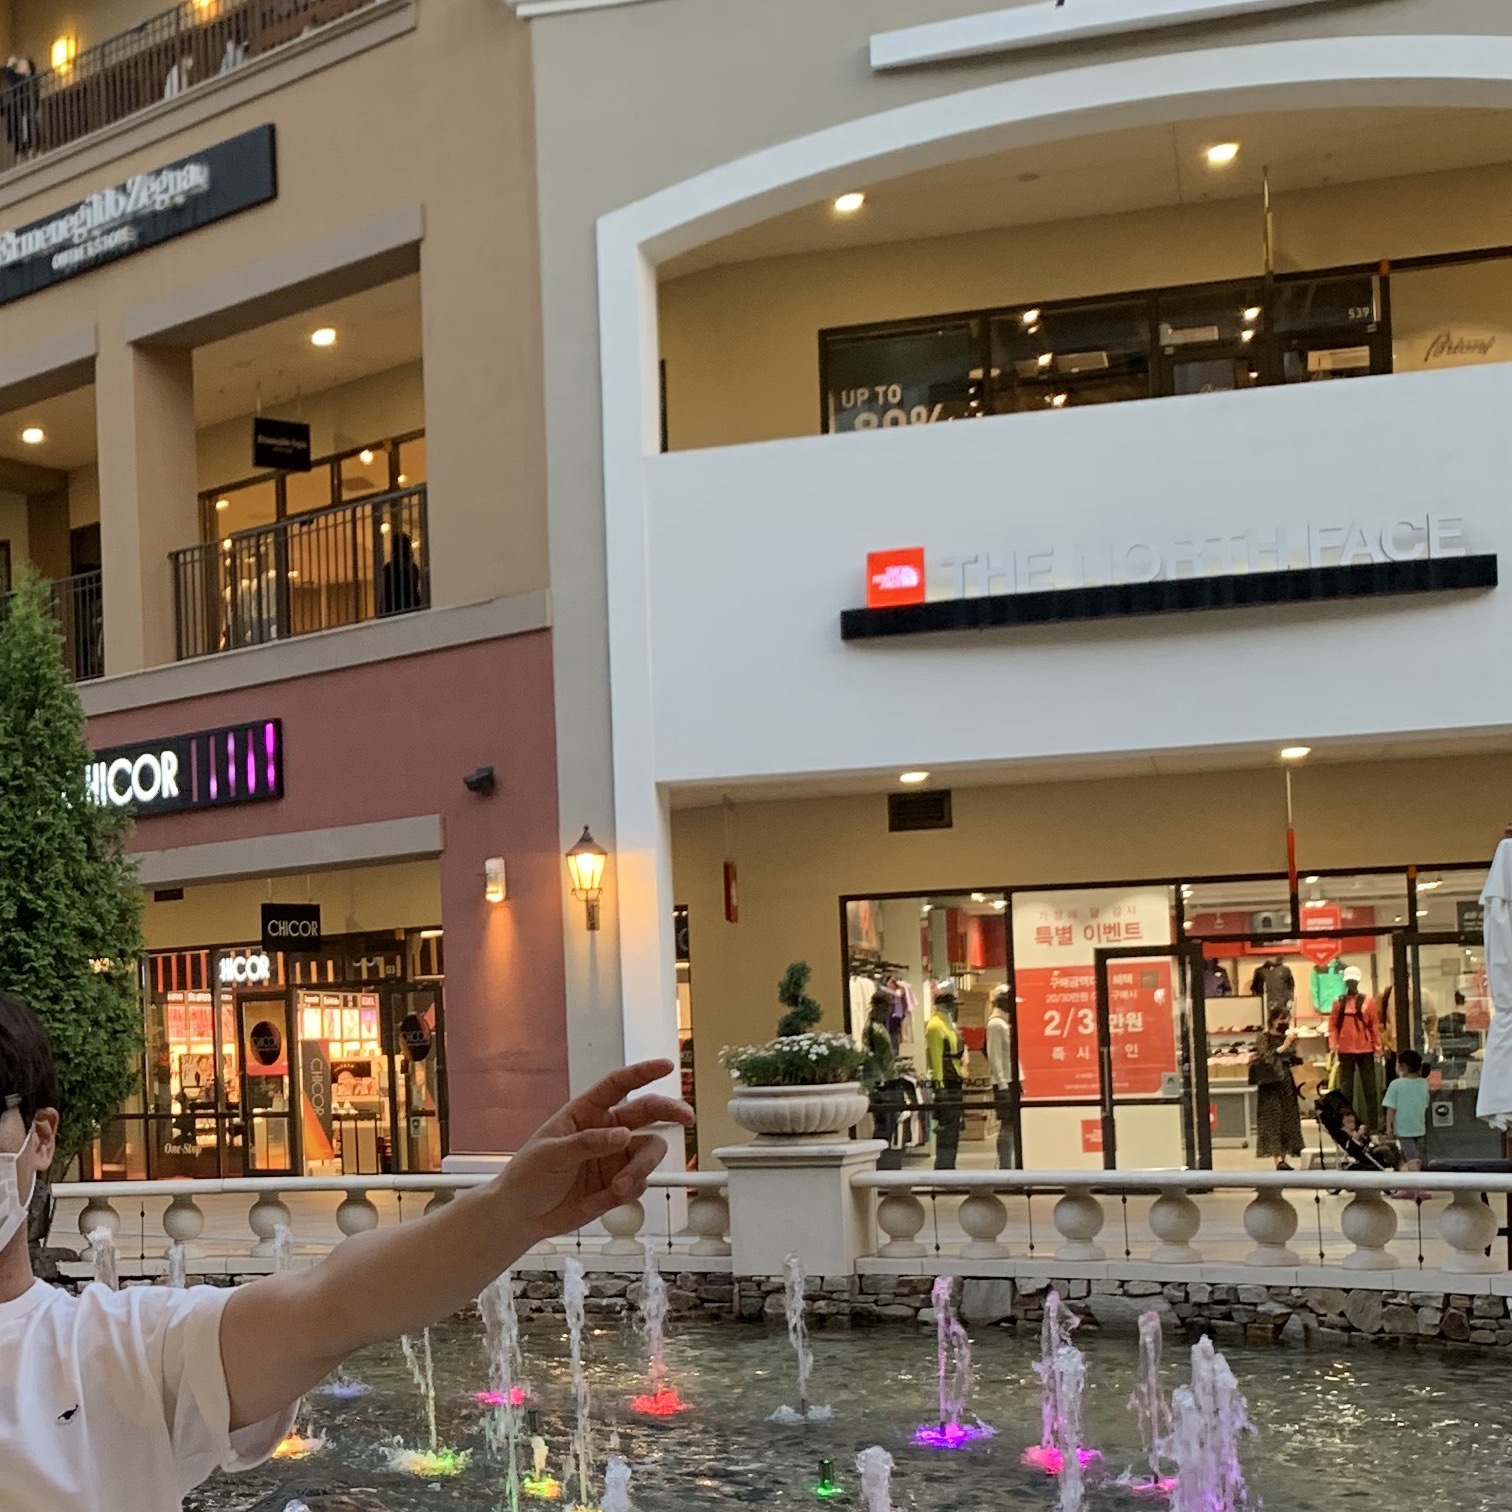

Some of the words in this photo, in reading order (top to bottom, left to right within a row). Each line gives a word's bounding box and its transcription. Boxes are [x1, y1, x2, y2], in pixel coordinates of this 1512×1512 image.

[841, 387, 870, 408] UP
[874, 383, 902, 405] TO
[941, 547, 1054, 600] THE
[1073, 527, 1286, 588] NORTH
[1307, 513, 1466, 569] FACE
[64, 750, 179, 808] HICOR
[267, 920, 318, 937] CHICOR
[1034, 924, 1073, 946] 특별
[1083, 922, 1143, 944] 이벤트
[219, 955, 270, 982] HICOR
[310, 1058, 325, 1116] CHICOR
